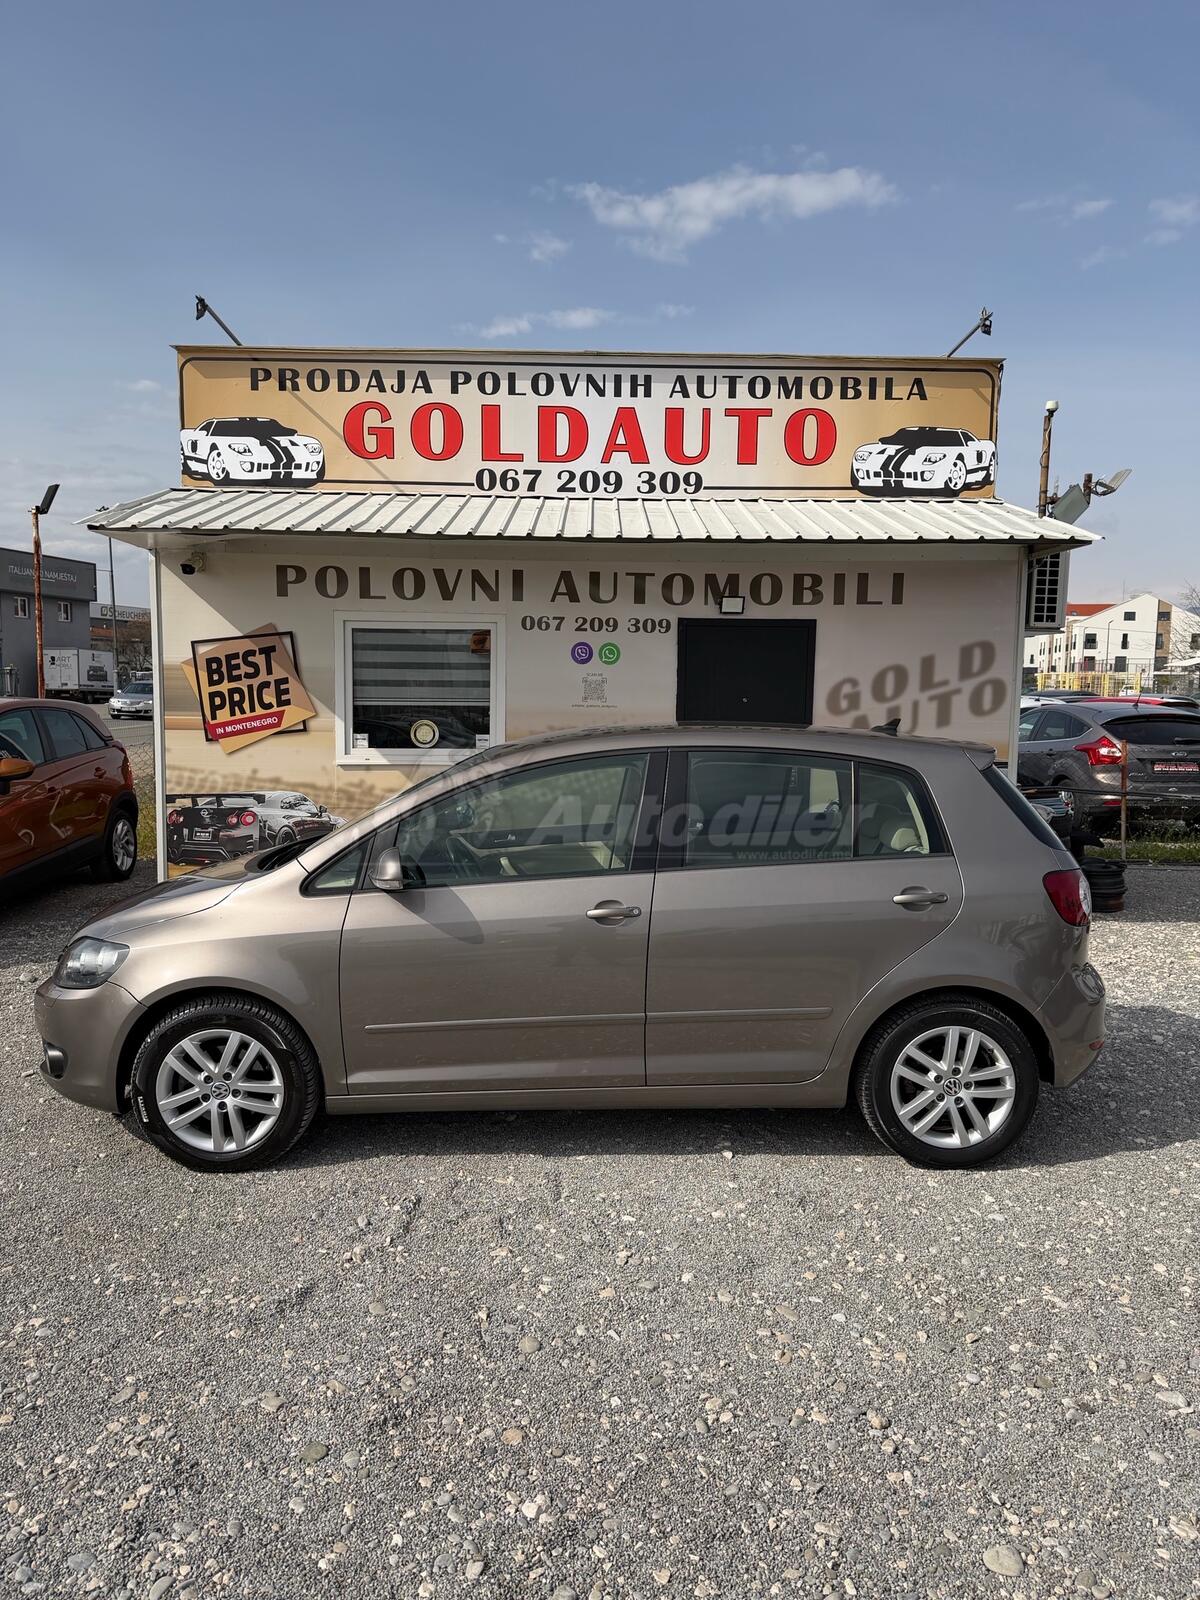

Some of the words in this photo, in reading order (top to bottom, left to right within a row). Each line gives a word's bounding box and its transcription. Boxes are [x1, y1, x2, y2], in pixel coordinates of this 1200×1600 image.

[250, 367, 432, 394] PRODAJA
[451, 371, 652, 399] POLOVNIH
[668, 374, 928, 402] AUTOMOBILA
[343, 401, 837, 466] GOLDAUTO
[476, 468, 546, 494] 067
[556, 470, 625, 495] 209
[637, 471, 704, 496] 309
[275, 564, 524, 602] POLOVNI
[549, 570, 905, 606] AUTOMOBILI
[521, 615, 566, 632] 067
[574, 616, 619, 633] 209
[627, 617, 672, 634] 309
[205, 645, 277, 688] BEST
[825, 640, 996, 716] GOLD
[207, 676, 292, 721] PRICE
[215, 726, 225, 735] IN
[225, 716, 279, 733] MONTENEGRO
